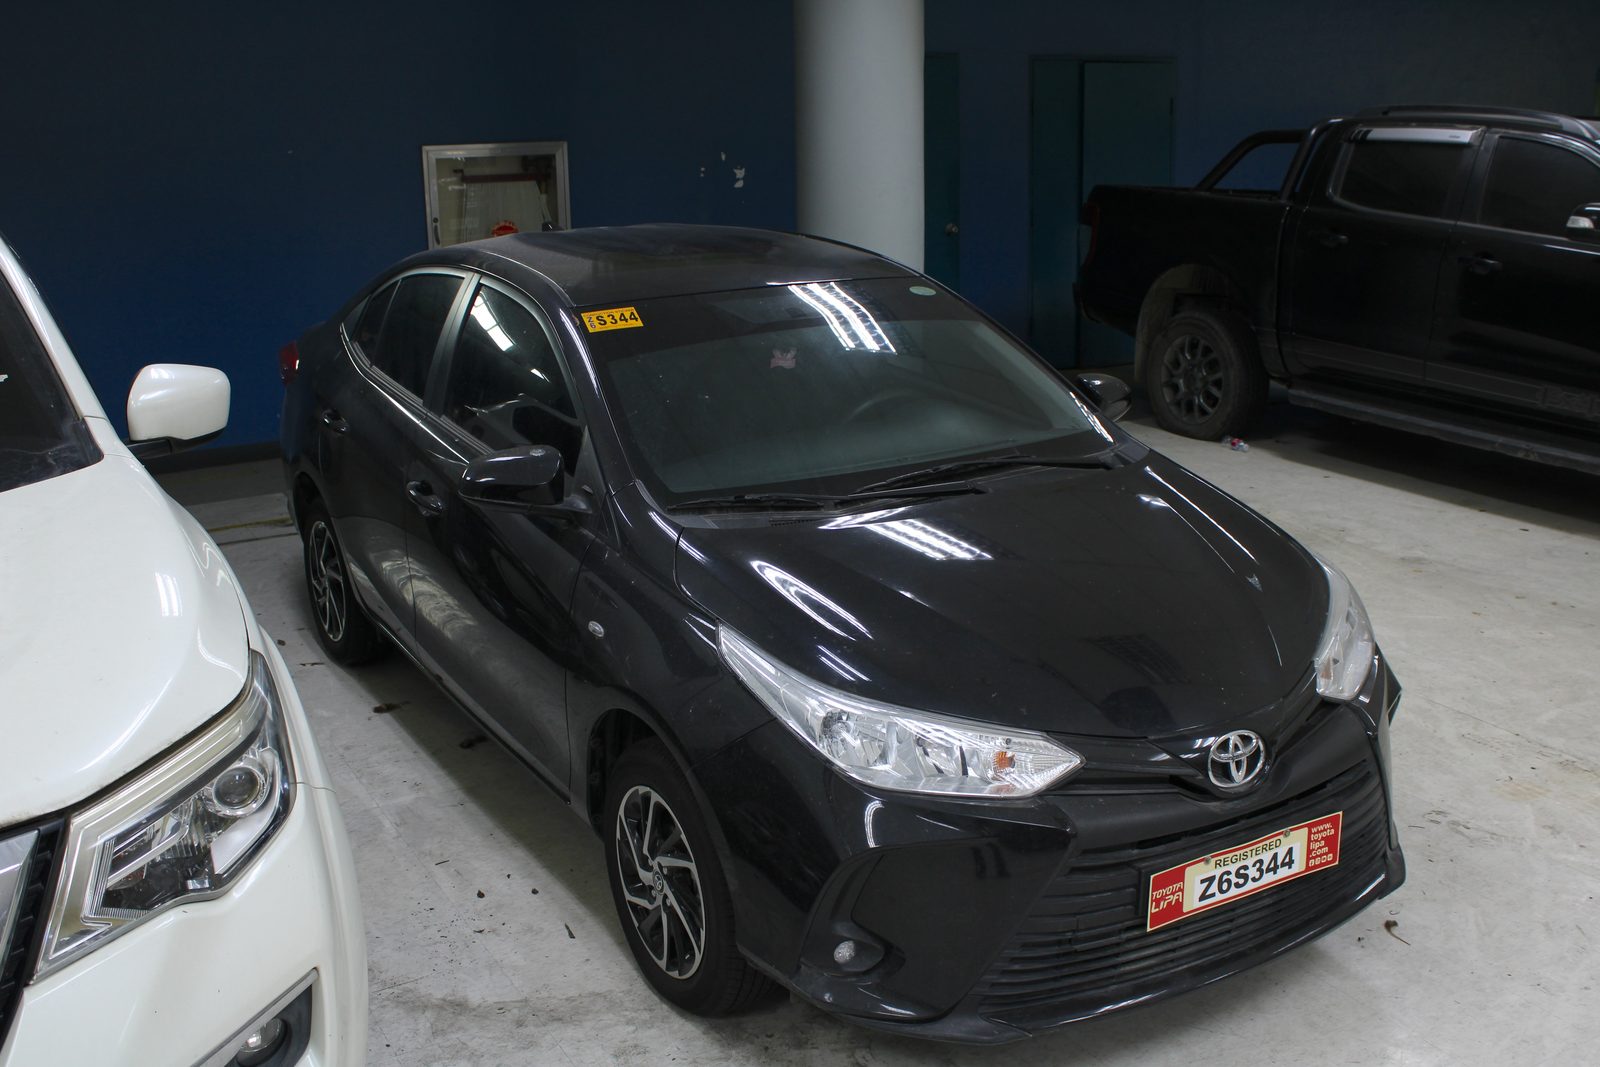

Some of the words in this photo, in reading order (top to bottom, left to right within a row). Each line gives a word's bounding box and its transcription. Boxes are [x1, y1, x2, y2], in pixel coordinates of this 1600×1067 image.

[596, 312, 638, 326] S344
[1311, 828, 1335, 841] toyota
[1310, 840, 1325, 850] lipa
[1310, 847, 1329, 858] .com
[1215, 839, 1282, 869] REGISTERED
[1198, 846, 1295, 902] Z6S344
[1152, 881, 1184, 900] TOYOTA
[1151, 891, 1183, 914] LIPA
